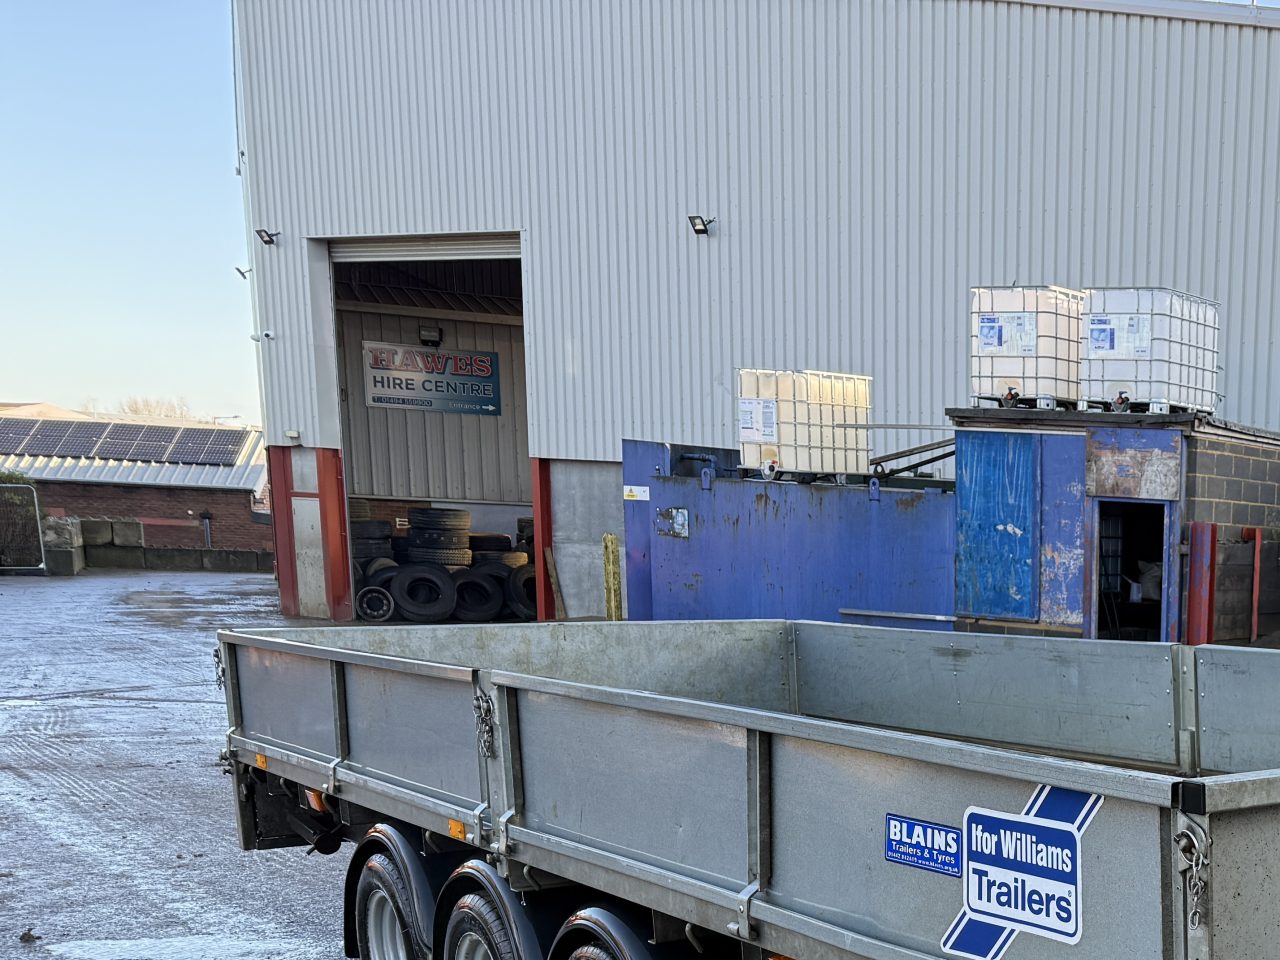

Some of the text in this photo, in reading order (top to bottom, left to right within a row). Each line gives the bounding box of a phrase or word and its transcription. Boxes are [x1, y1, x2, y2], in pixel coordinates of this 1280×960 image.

[369, 348, 493, 377] HAWES
[373, 375, 493, 397] HIRE CENTRE
[449, 402, 480, 410] Entrance
[889, 819, 958, 854] BLAINS
[971, 823, 1072, 873] Ifor Williams
[892, 841, 955, 864] Trailers & Tyres
[972, 867, 1072, 923] Trailers
